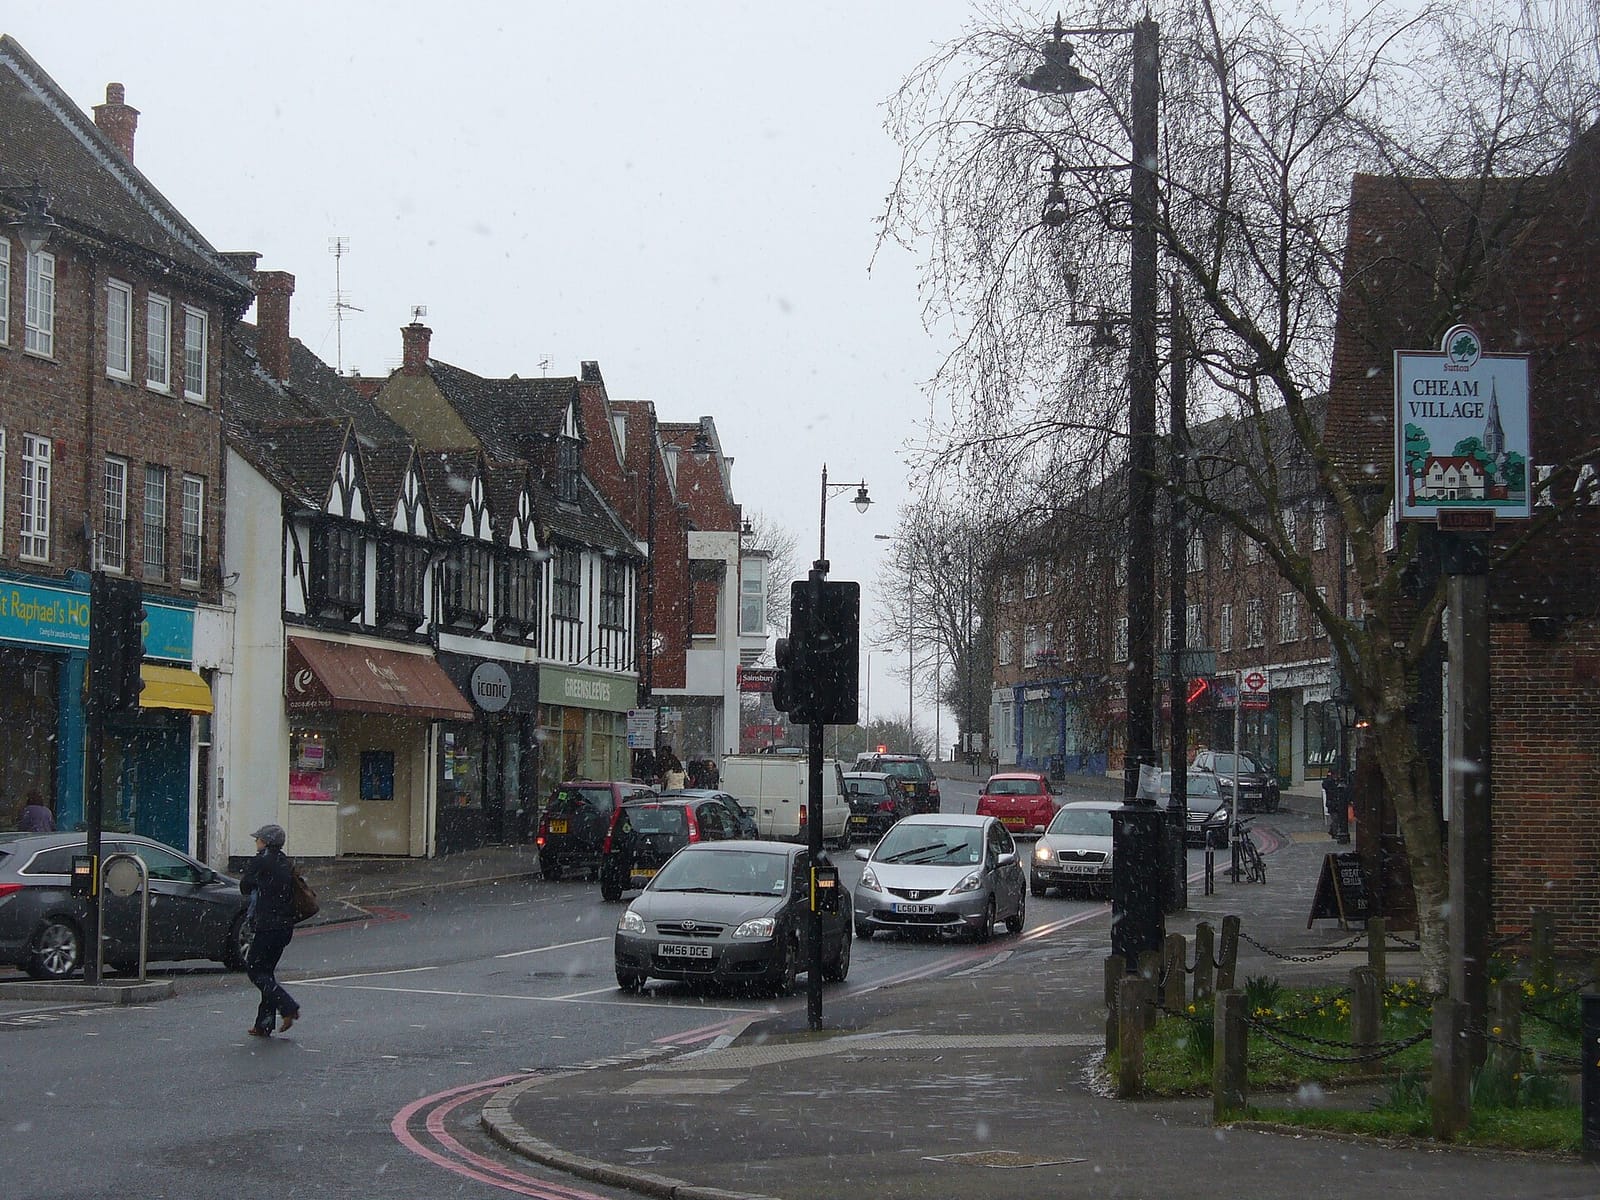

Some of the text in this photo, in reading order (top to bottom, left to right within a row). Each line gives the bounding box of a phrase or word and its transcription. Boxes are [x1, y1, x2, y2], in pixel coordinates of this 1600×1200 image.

[1412, 379, 1480, 397] CHEAM
[1408, 401, 1485, 419] VILLAGE
[11, 591, 65, 627] Raphael's
[477, 675, 507, 699] iconic
[565, 678, 611, 702] GREENSLEEVES
[690, 946, 710, 957] DCE
